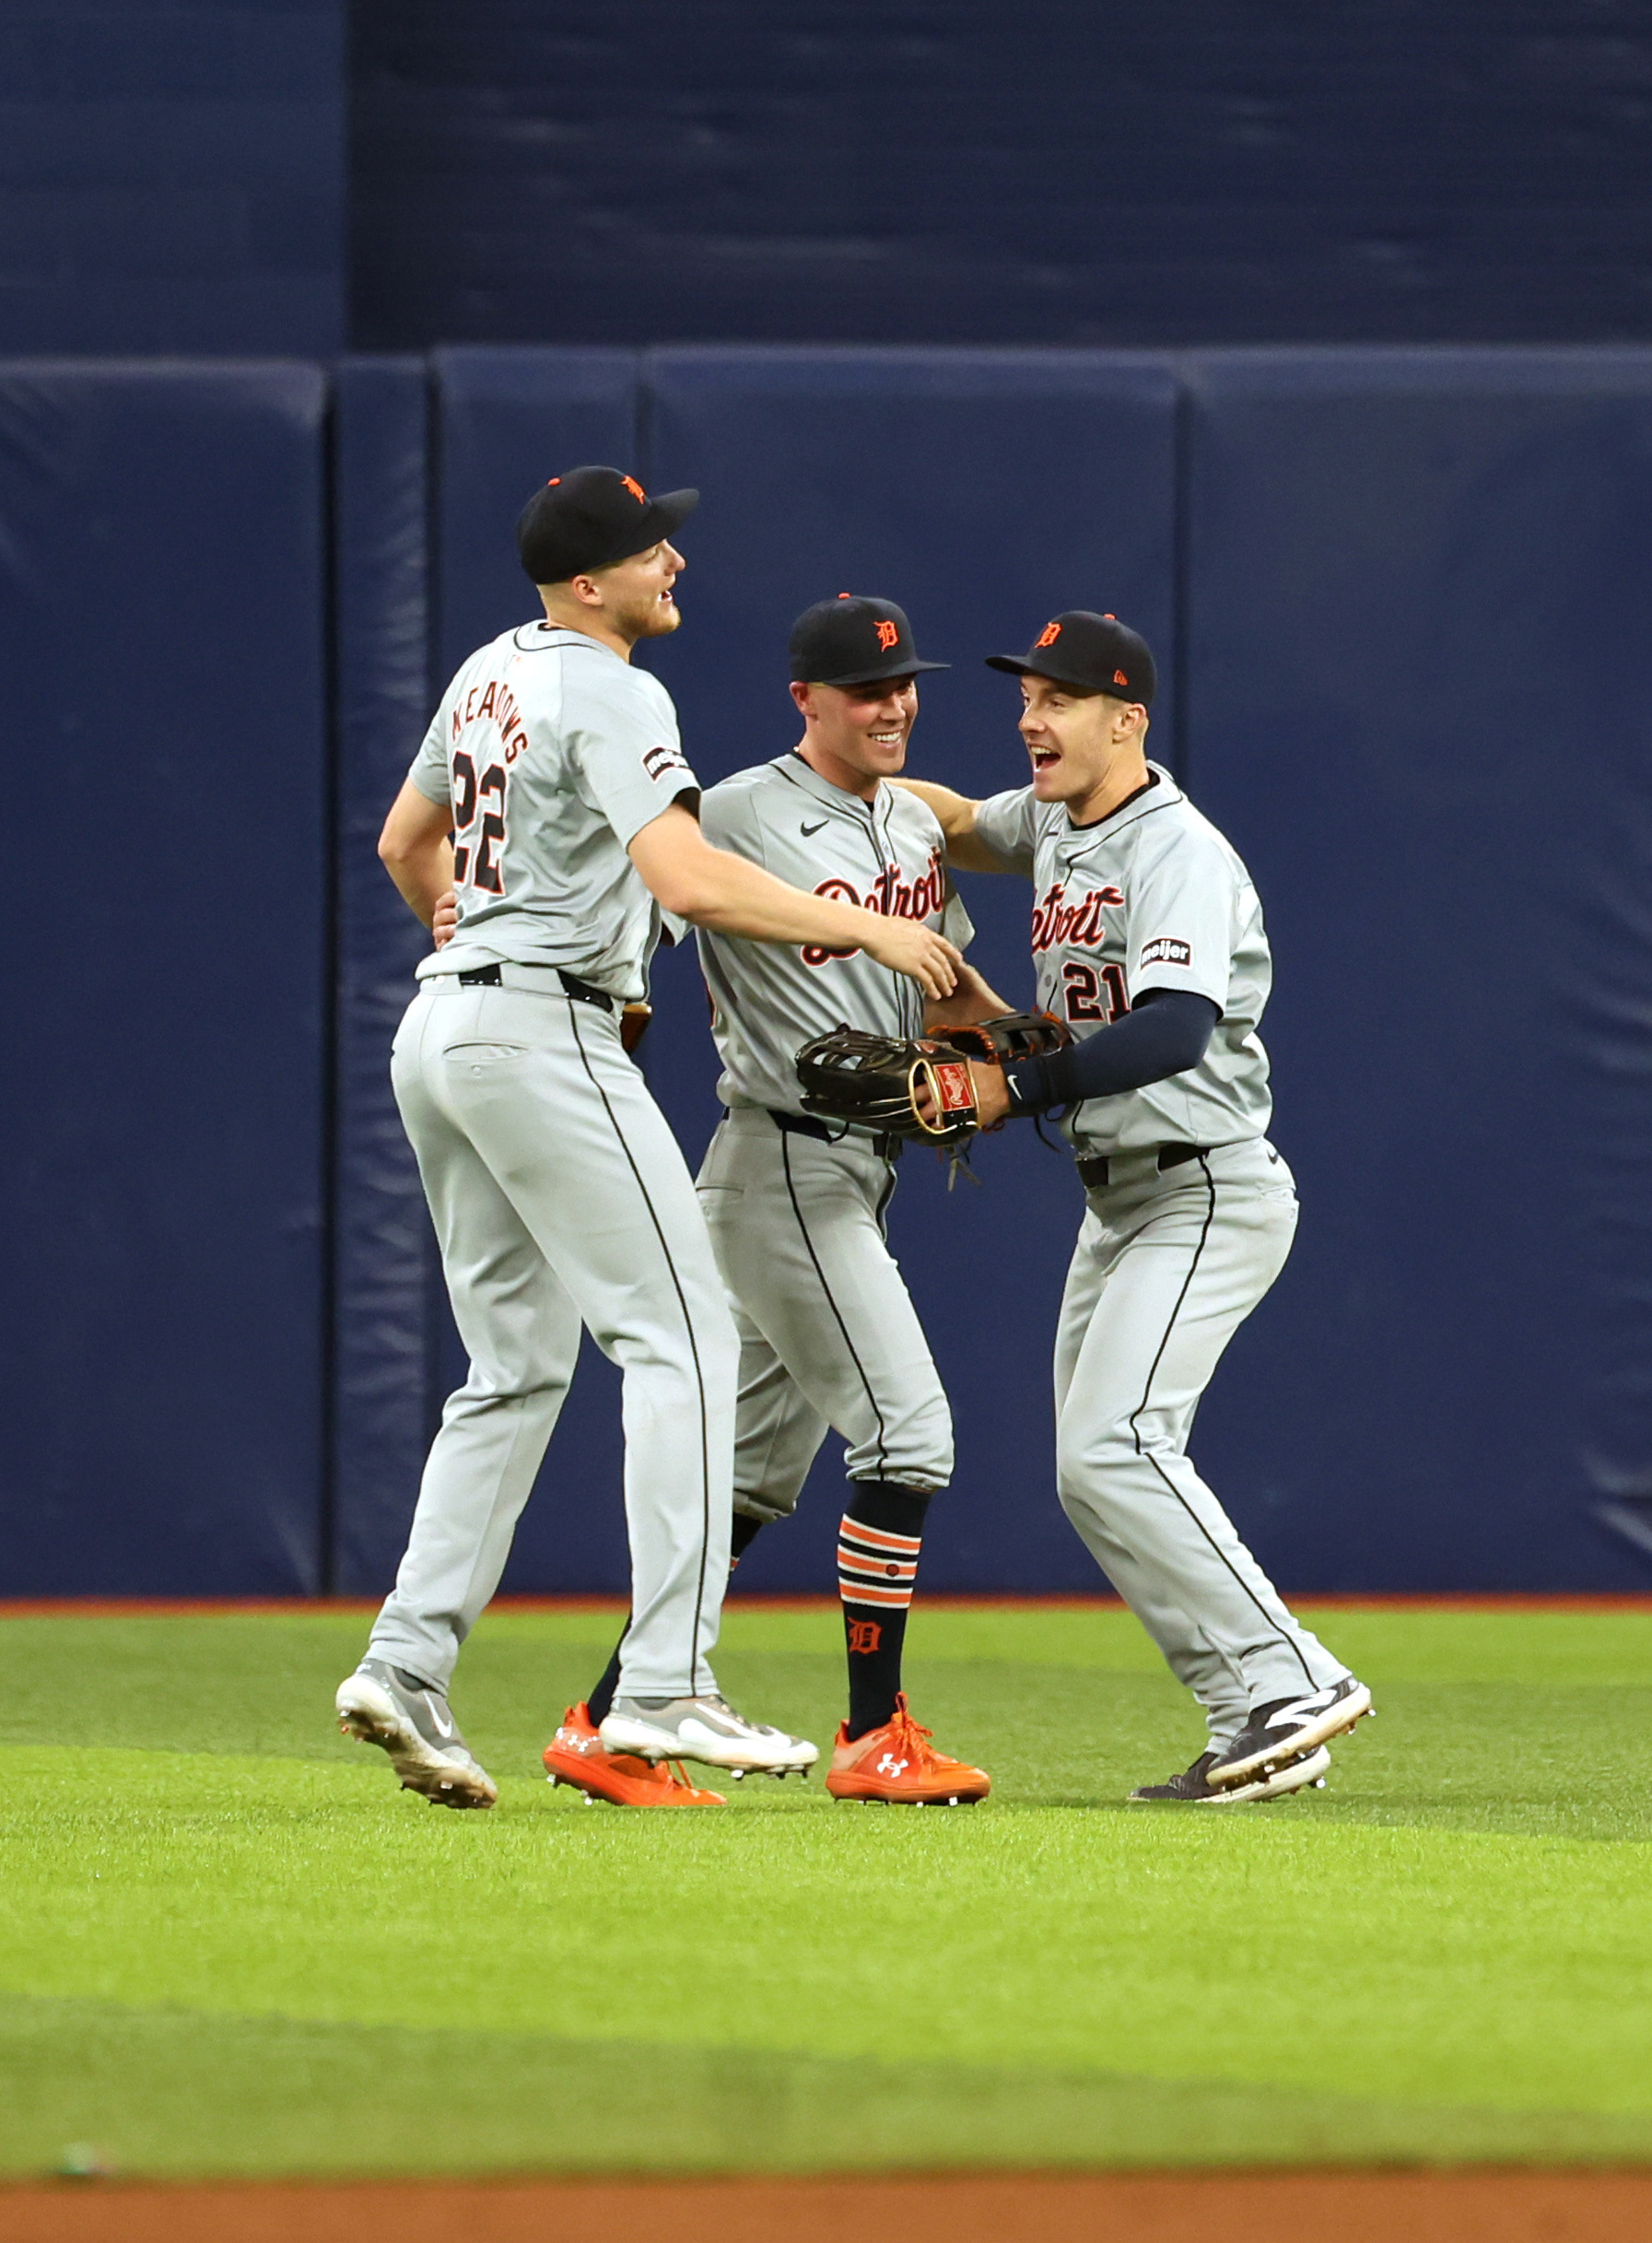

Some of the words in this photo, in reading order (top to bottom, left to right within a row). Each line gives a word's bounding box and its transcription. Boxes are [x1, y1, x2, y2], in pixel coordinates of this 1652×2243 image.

[873, 620, 899, 652] D
[1034, 622, 1061, 649] D
[452, 681, 528, 764] MEADOWS
[1142, 940, 1189, 965] meijer
[1063, 962, 1131, 1023] 21
[848, 1616, 882, 1654] D
